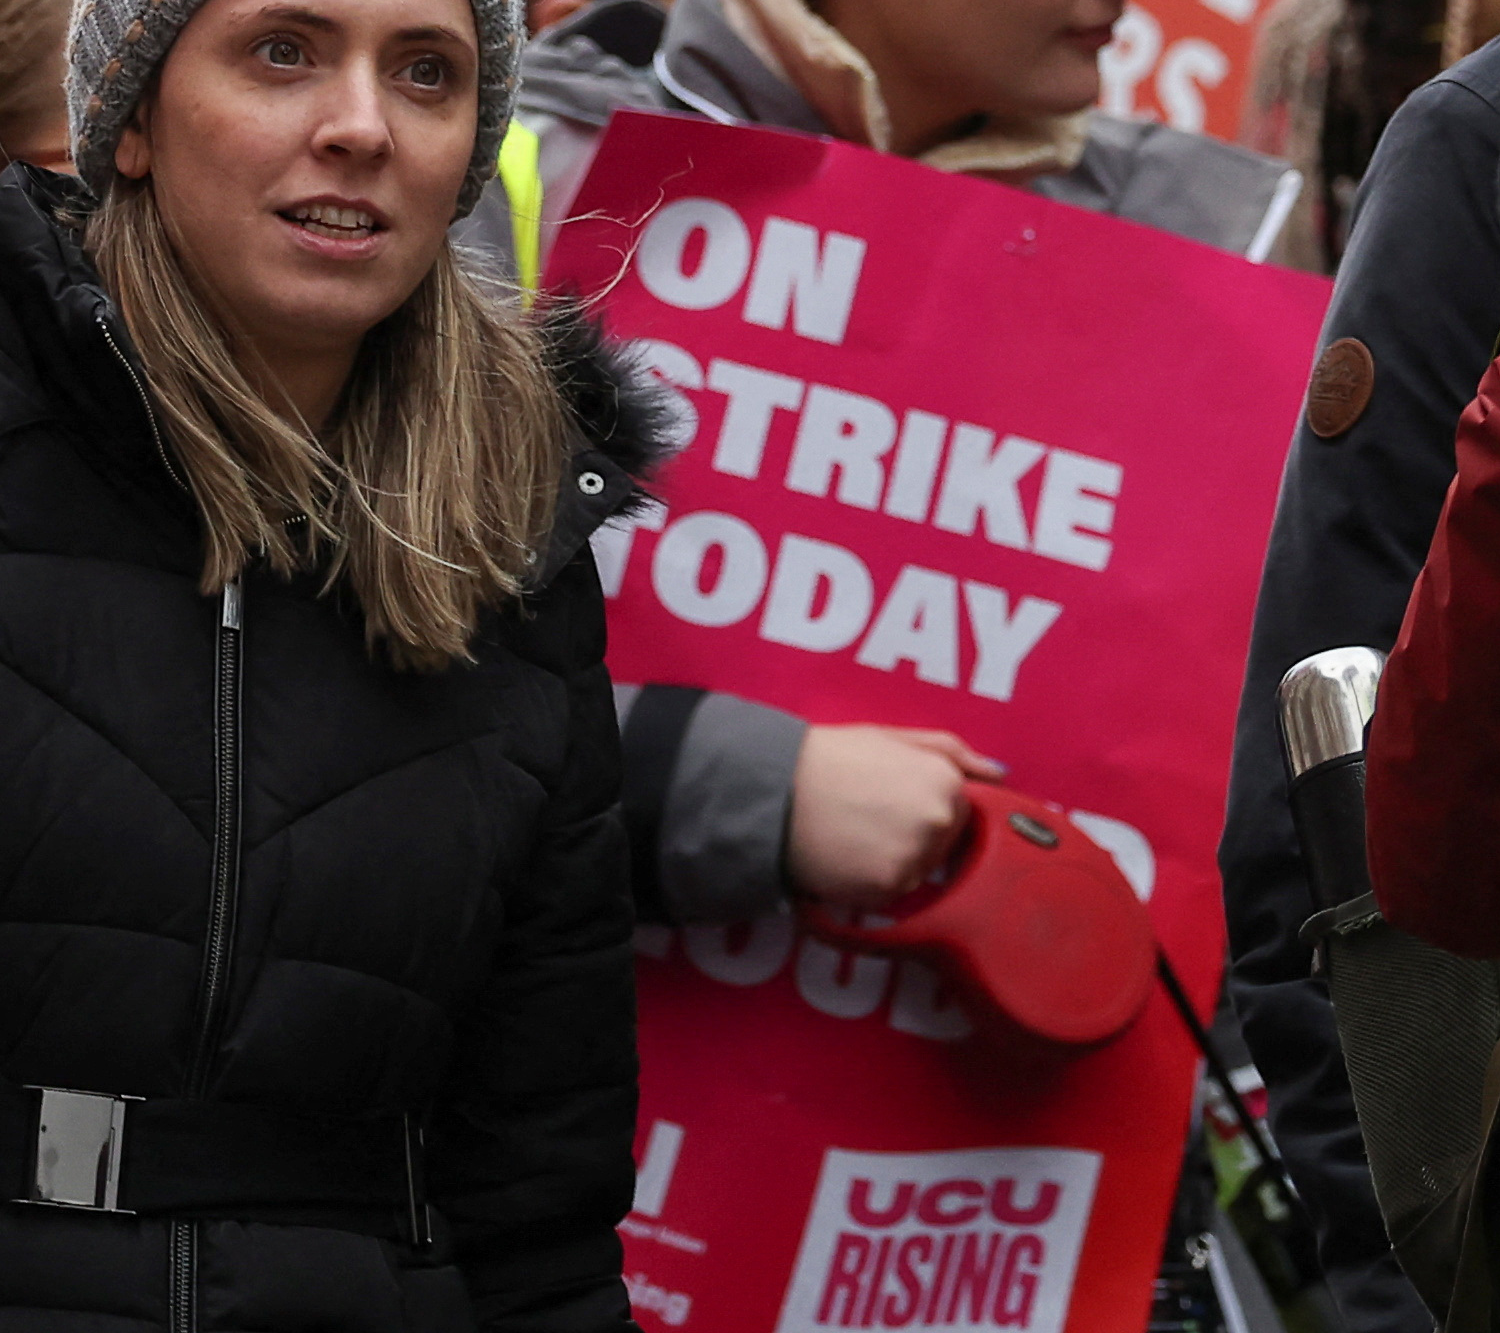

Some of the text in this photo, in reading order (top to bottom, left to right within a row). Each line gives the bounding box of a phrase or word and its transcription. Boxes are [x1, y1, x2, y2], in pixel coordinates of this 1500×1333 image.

[632, 196, 867, 344] ON
[846, 1178, 1062, 1228] UCU
[813, 1231, 1045, 1331] RISING
